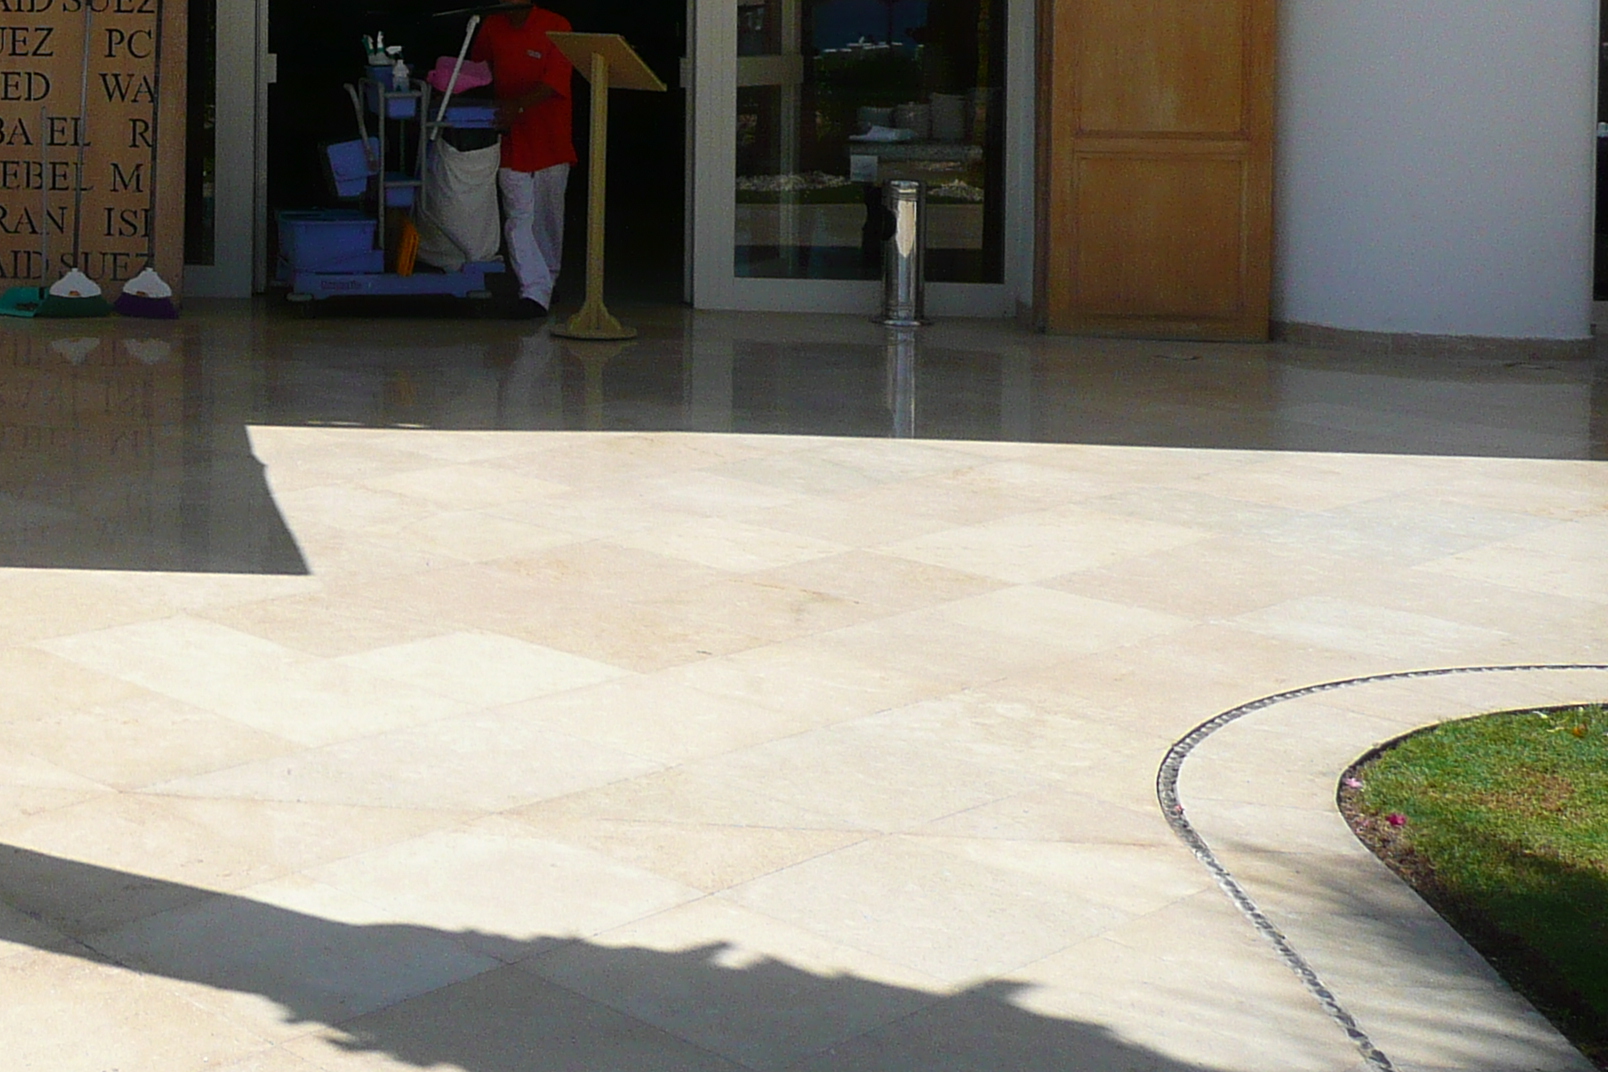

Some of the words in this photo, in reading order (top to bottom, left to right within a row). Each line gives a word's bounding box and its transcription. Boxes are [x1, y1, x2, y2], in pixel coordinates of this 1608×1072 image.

[105, 28, 152, 58] PC
[99, 73, 155, 103] WA
[47, 117, 91, 147] EL
[129, 118, 153, 148] R
[110, 162, 144, 193] M
